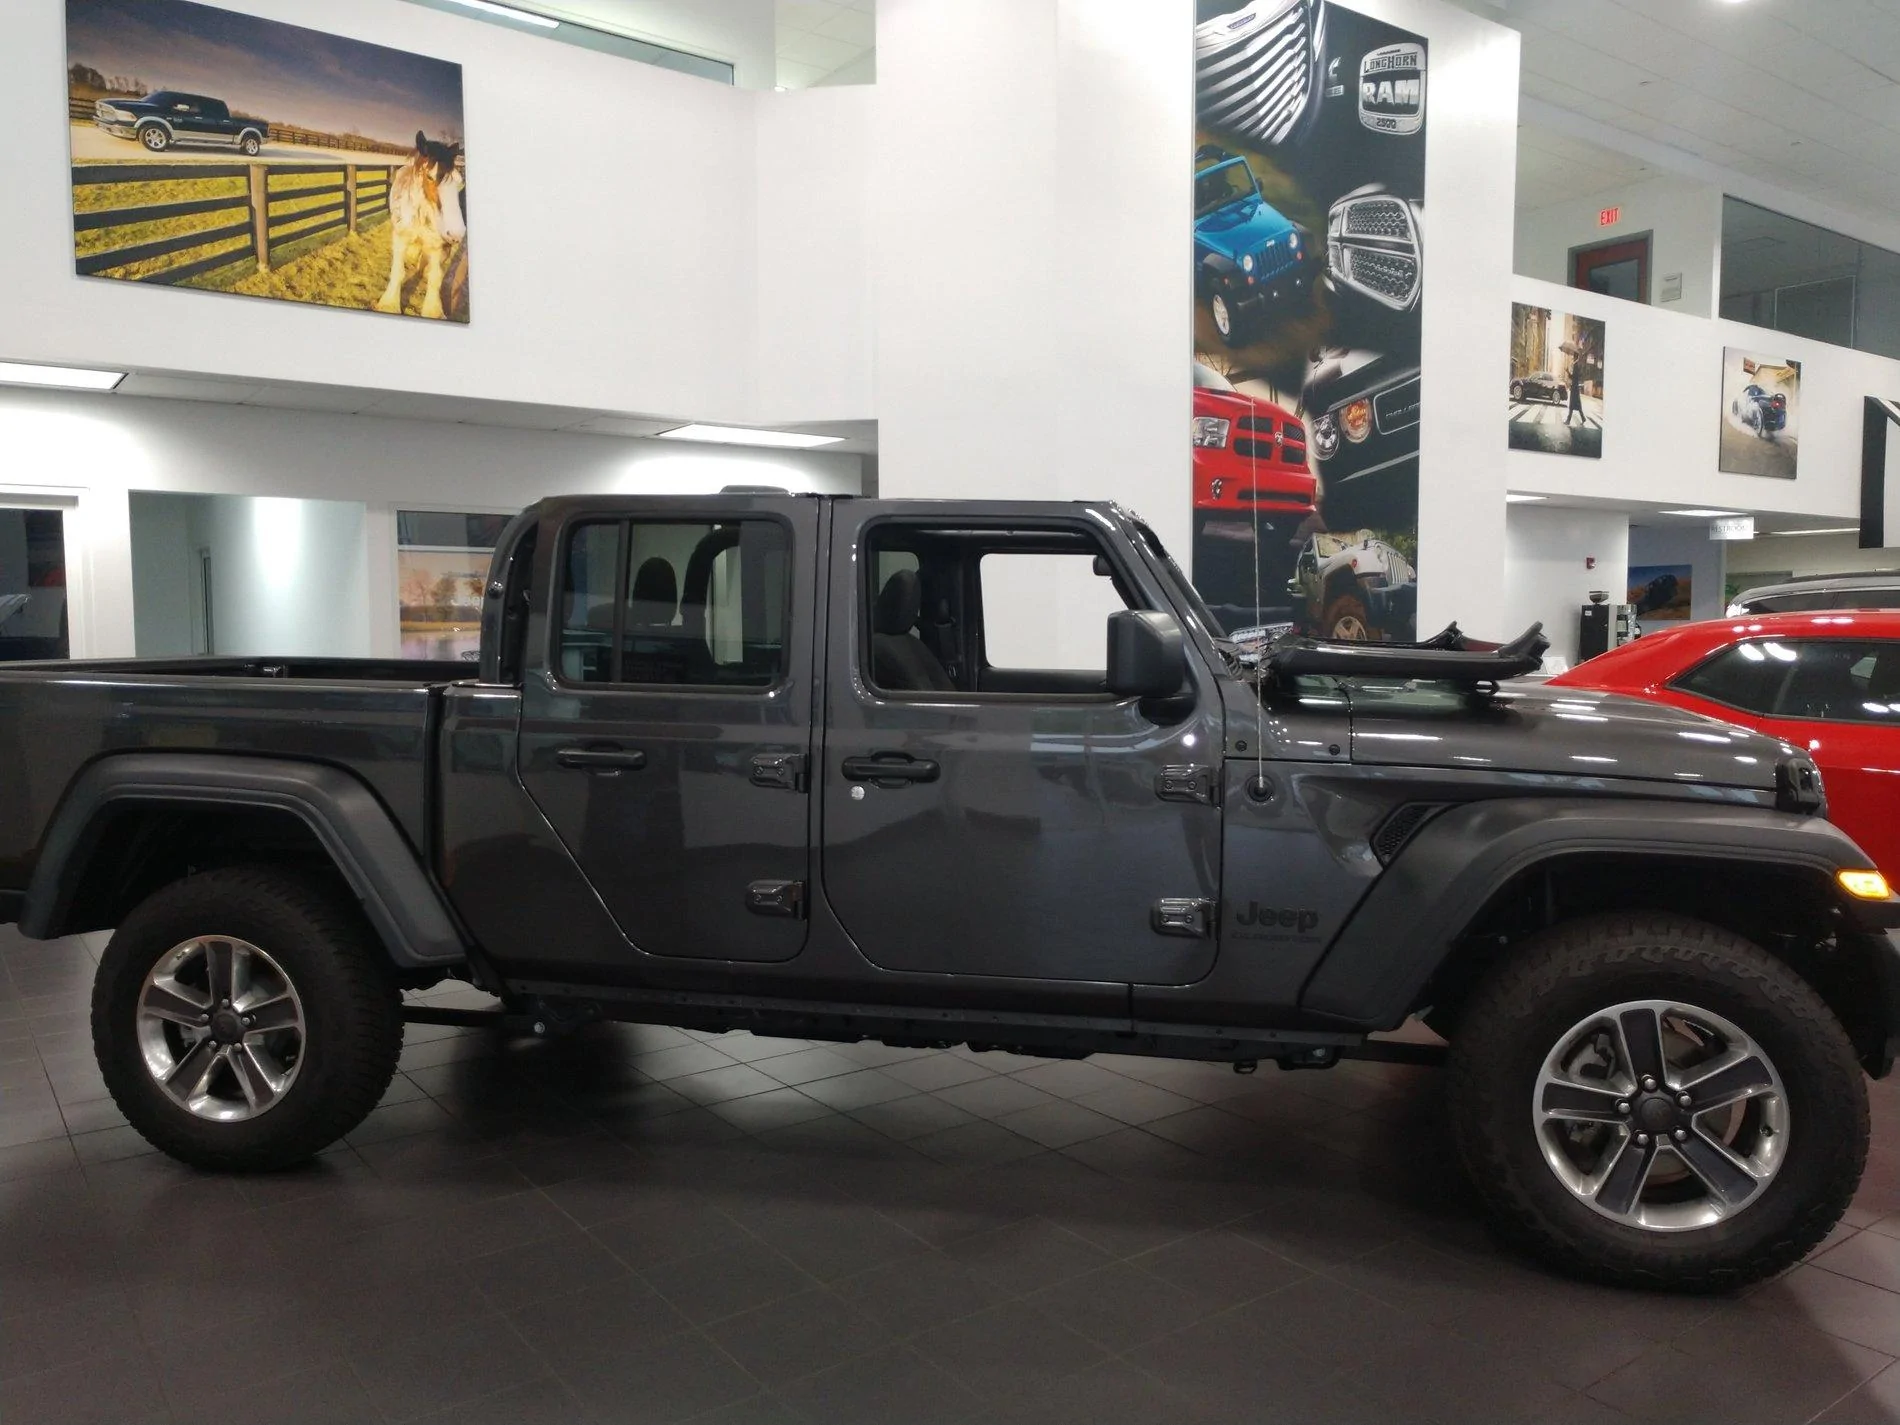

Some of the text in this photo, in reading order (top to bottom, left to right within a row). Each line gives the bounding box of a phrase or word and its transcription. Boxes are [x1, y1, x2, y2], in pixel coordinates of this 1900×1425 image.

[1363, 54, 1418, 73] LONGHORN
[1362, 80, 1420, 105] RAM
[1600, 207, 1619, 225] EXIT
[1236, 901, 1319, 934] Jeep
